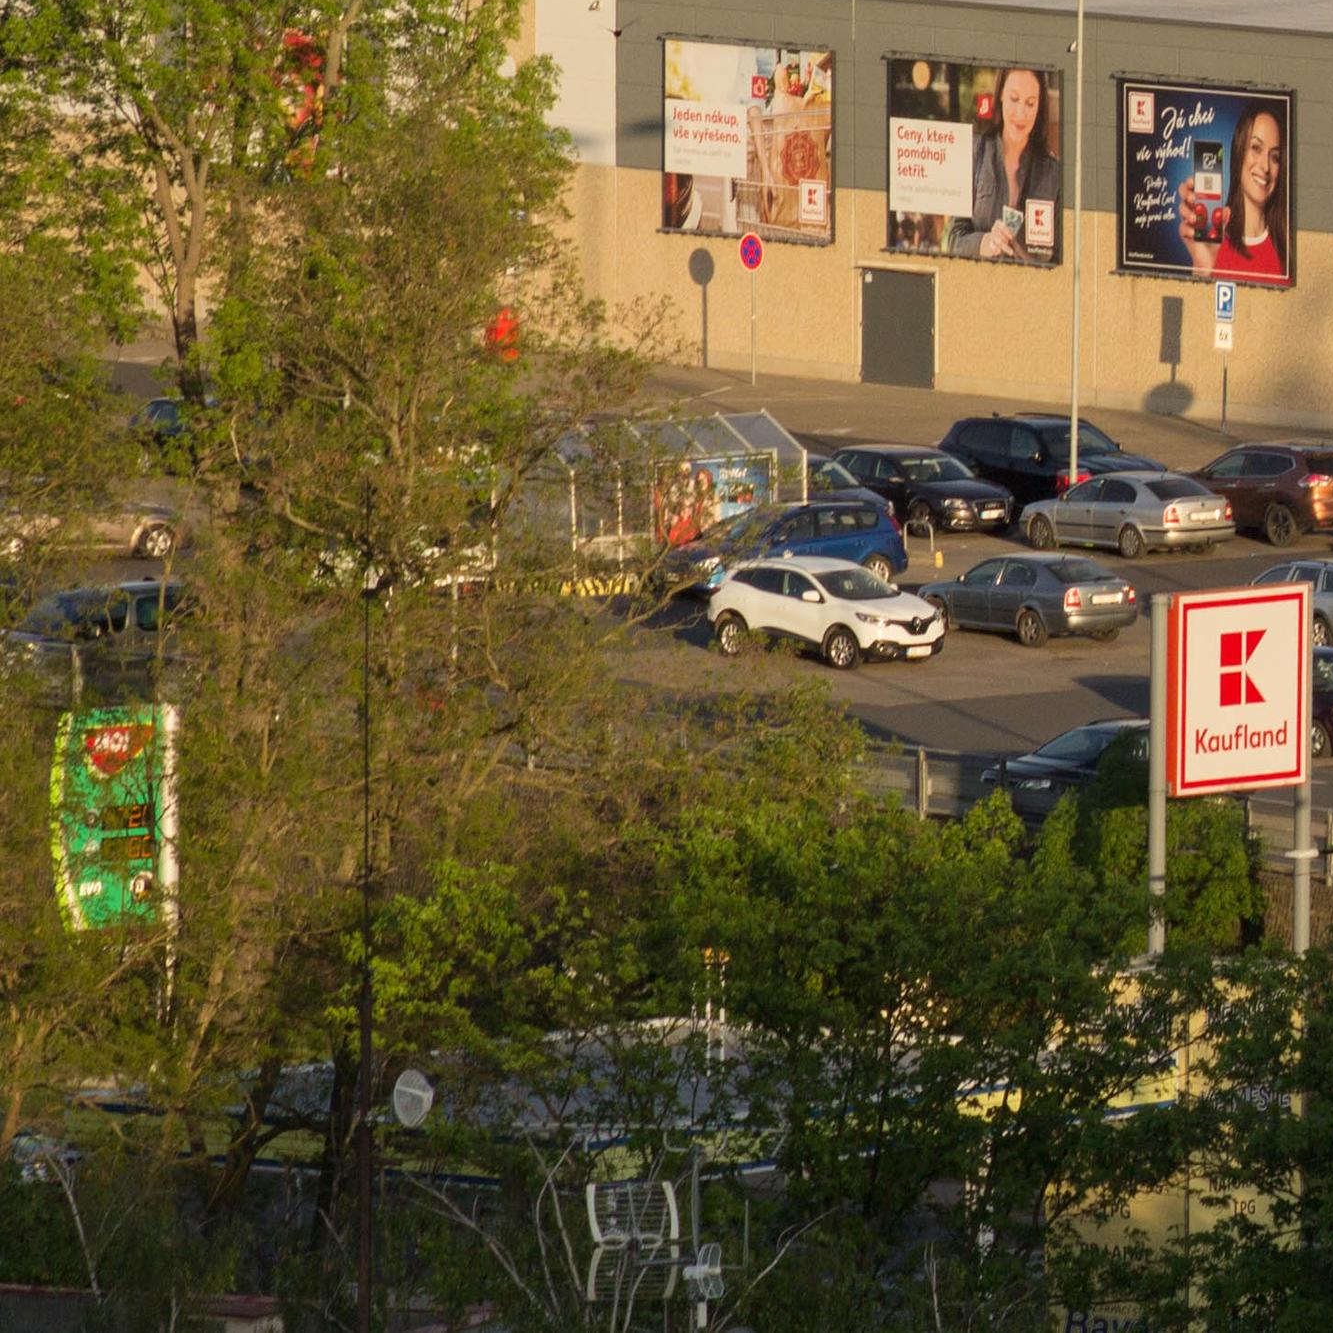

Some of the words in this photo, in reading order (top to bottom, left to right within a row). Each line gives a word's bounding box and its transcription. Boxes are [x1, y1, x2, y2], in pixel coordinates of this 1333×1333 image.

[672, 107, 702, 121] Jeden
[1160, 106, 1187, 140] Já
[1188, 101, 1215, 127] chci
[672, 125, 690, 139] vše
[692, 128, 741, 144] vyřešeno.
[896, 125, 924, 144] Ceny,
[926, 128, 956, 144] které
[1155, 135, 1192, 170] výhod!
[1219, 286, 1232, 310] P
[1195, 720, 1287, 755] Kaufland
